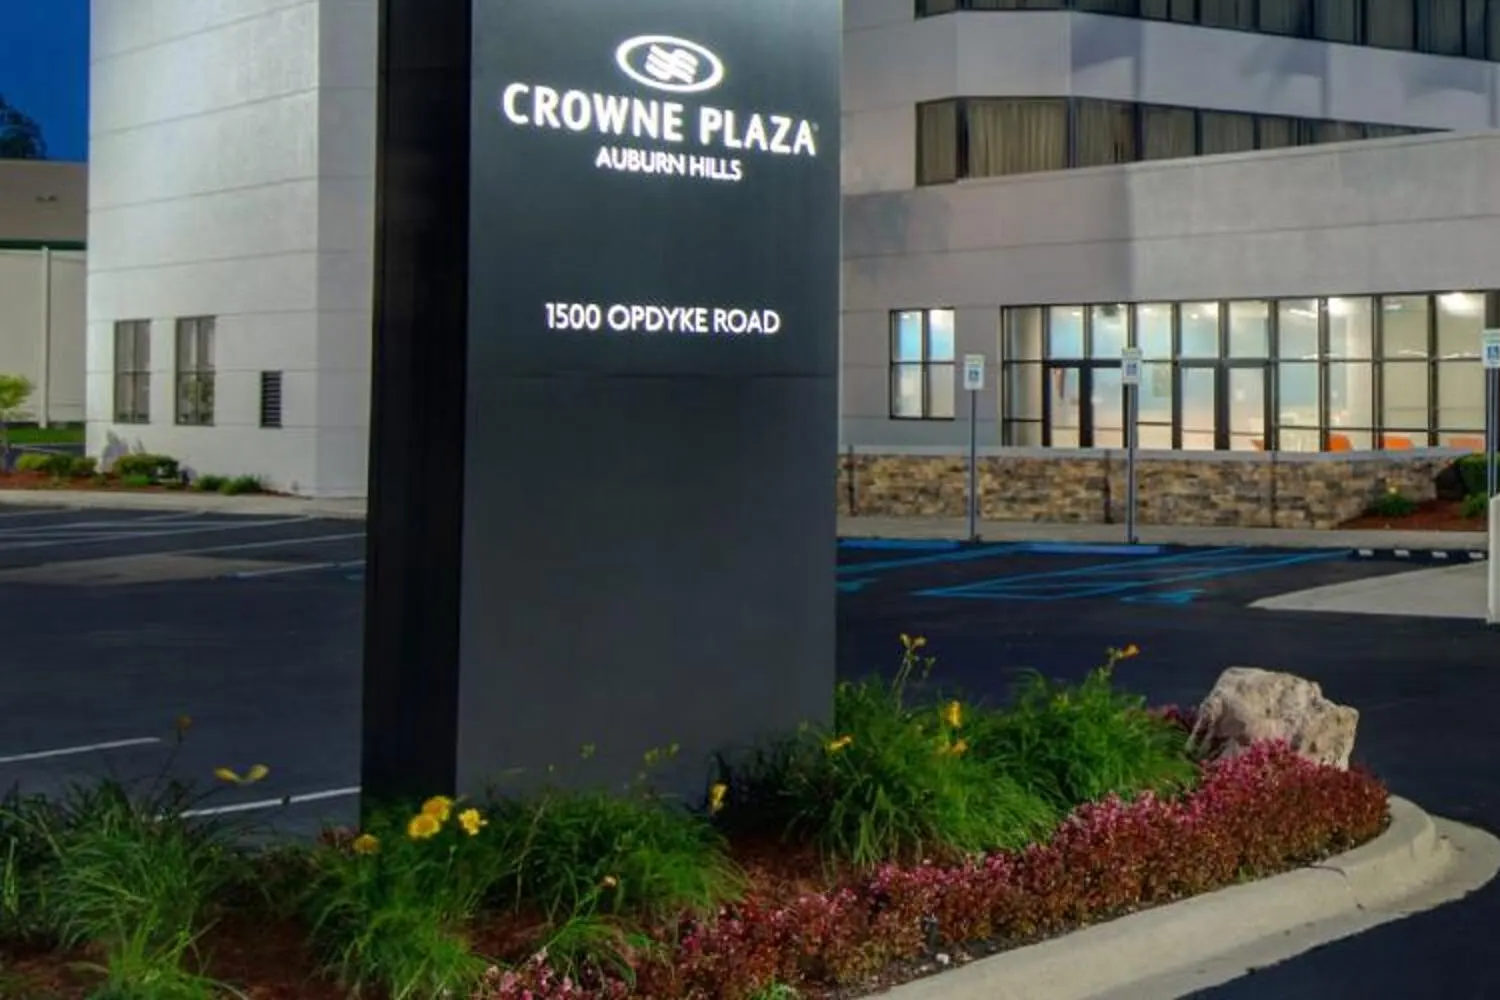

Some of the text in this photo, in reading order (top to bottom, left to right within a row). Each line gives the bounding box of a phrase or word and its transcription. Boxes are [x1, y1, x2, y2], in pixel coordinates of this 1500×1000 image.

[502, 83, 817, 156] CROWNE PLAZA
[595, 146, 743, 182] AUBURN HILLS
[545, 302, 781, 335] 1500 OPDYKE ROAD
